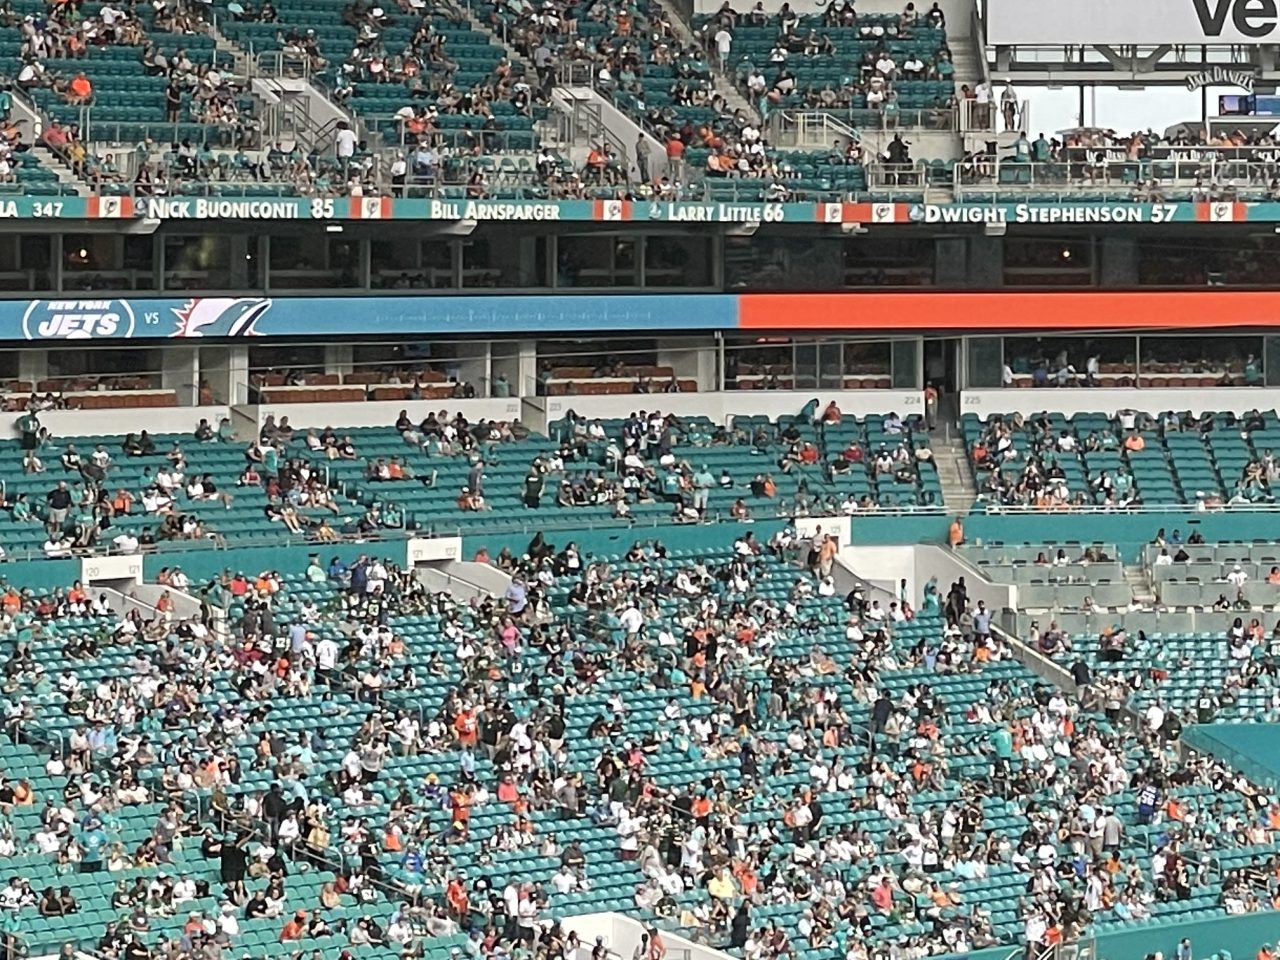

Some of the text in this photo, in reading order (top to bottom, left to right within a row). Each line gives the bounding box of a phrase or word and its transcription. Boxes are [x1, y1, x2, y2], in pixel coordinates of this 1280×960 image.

[1186, 72, 1214, 92] JACK
[32, 202, 63, 217] 347
[148, 198, 335, 219] NICK BUONICONTI 85
[430, 199, 561, 221] BILL ARNSPARGER
[668, 202, 785, 222] LARRY LITTLE 66
[924, 204, 1178, 223] DWIGHT STEPHENSON 57
[38, 313, 120, 337] JETS
[904, 396, 921, 405] 224
[964, 396, 981, 405] 225
[1140, 791, 1155, 806] 56
